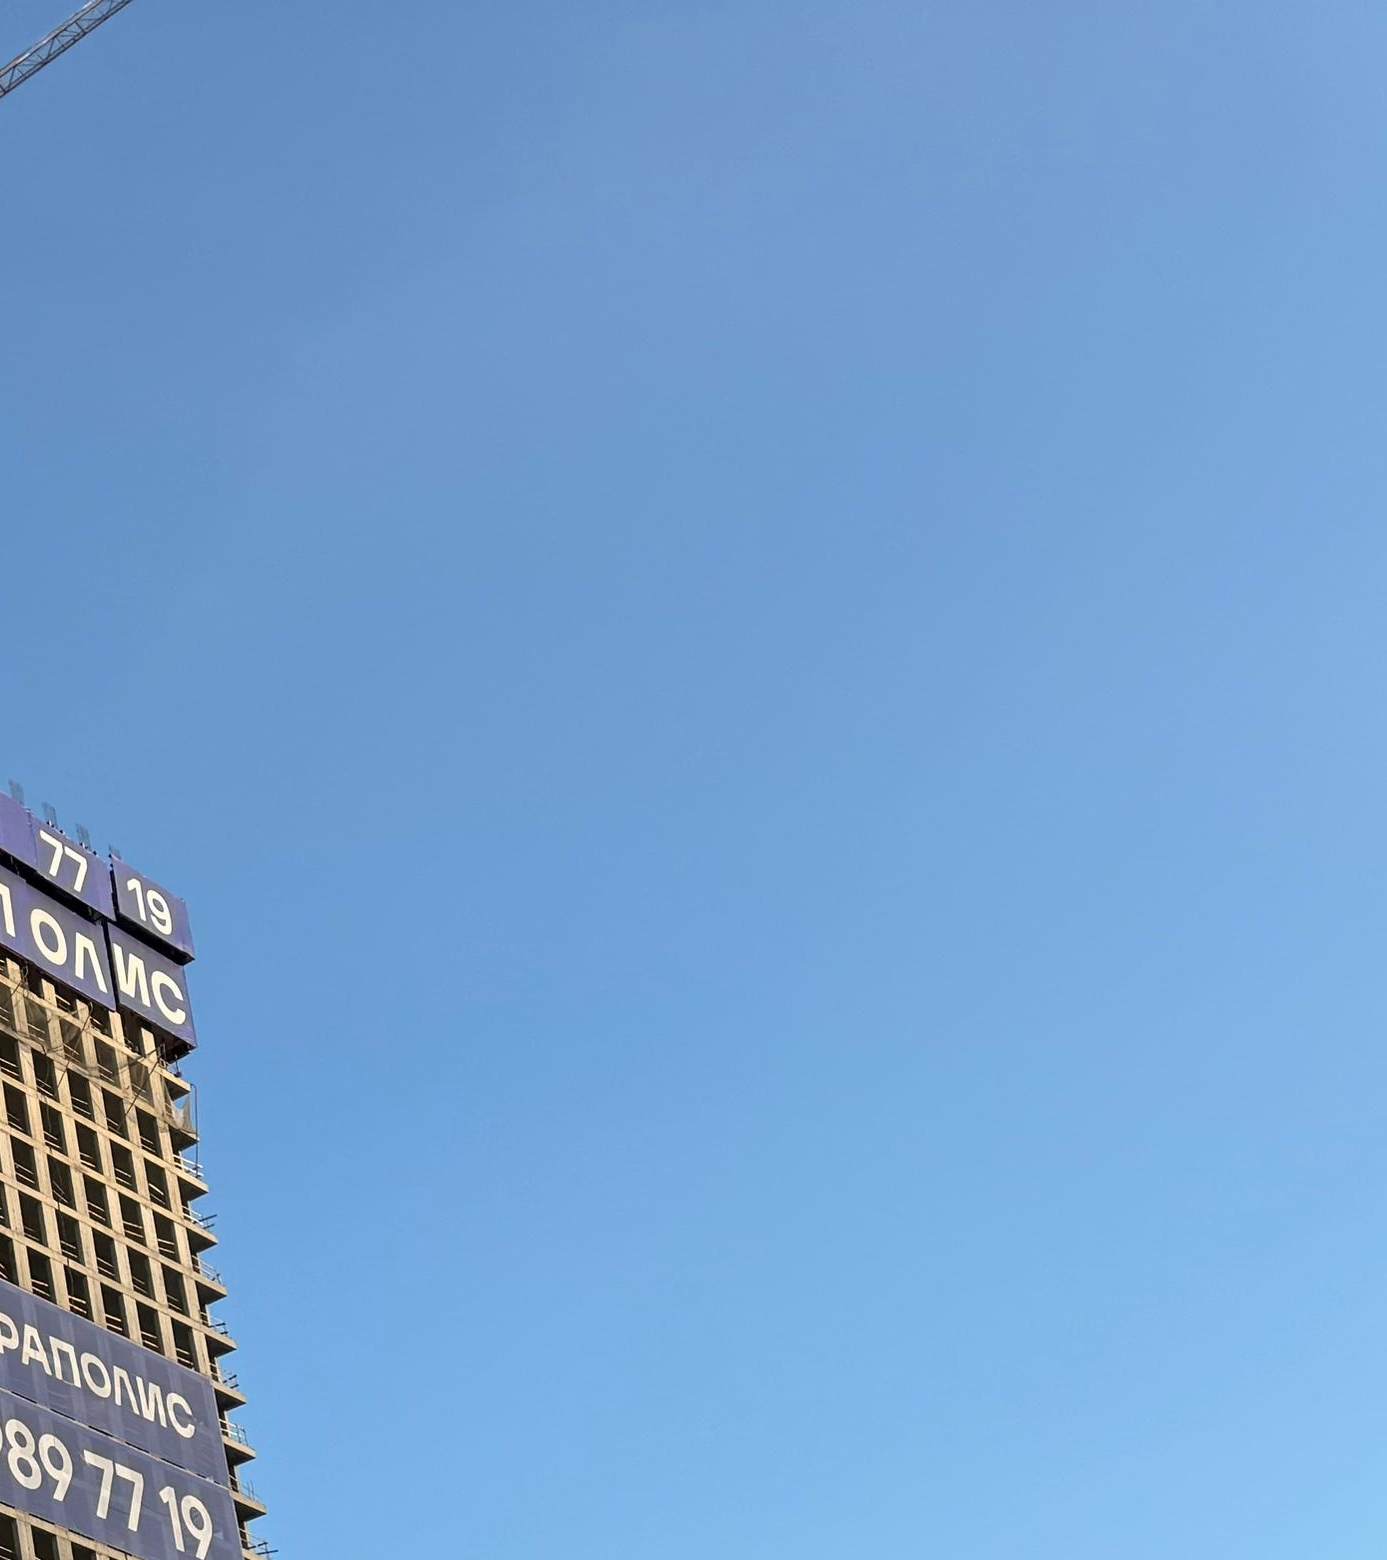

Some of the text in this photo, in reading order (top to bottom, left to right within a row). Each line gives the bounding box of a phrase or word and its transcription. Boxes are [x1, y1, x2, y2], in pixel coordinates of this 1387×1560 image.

[39, 829, 88, 893] 77
[127, 879, 172, 936] 19
[83, 1450, 144, 1532] 77
[159, 1486, 213, 1560] 19
